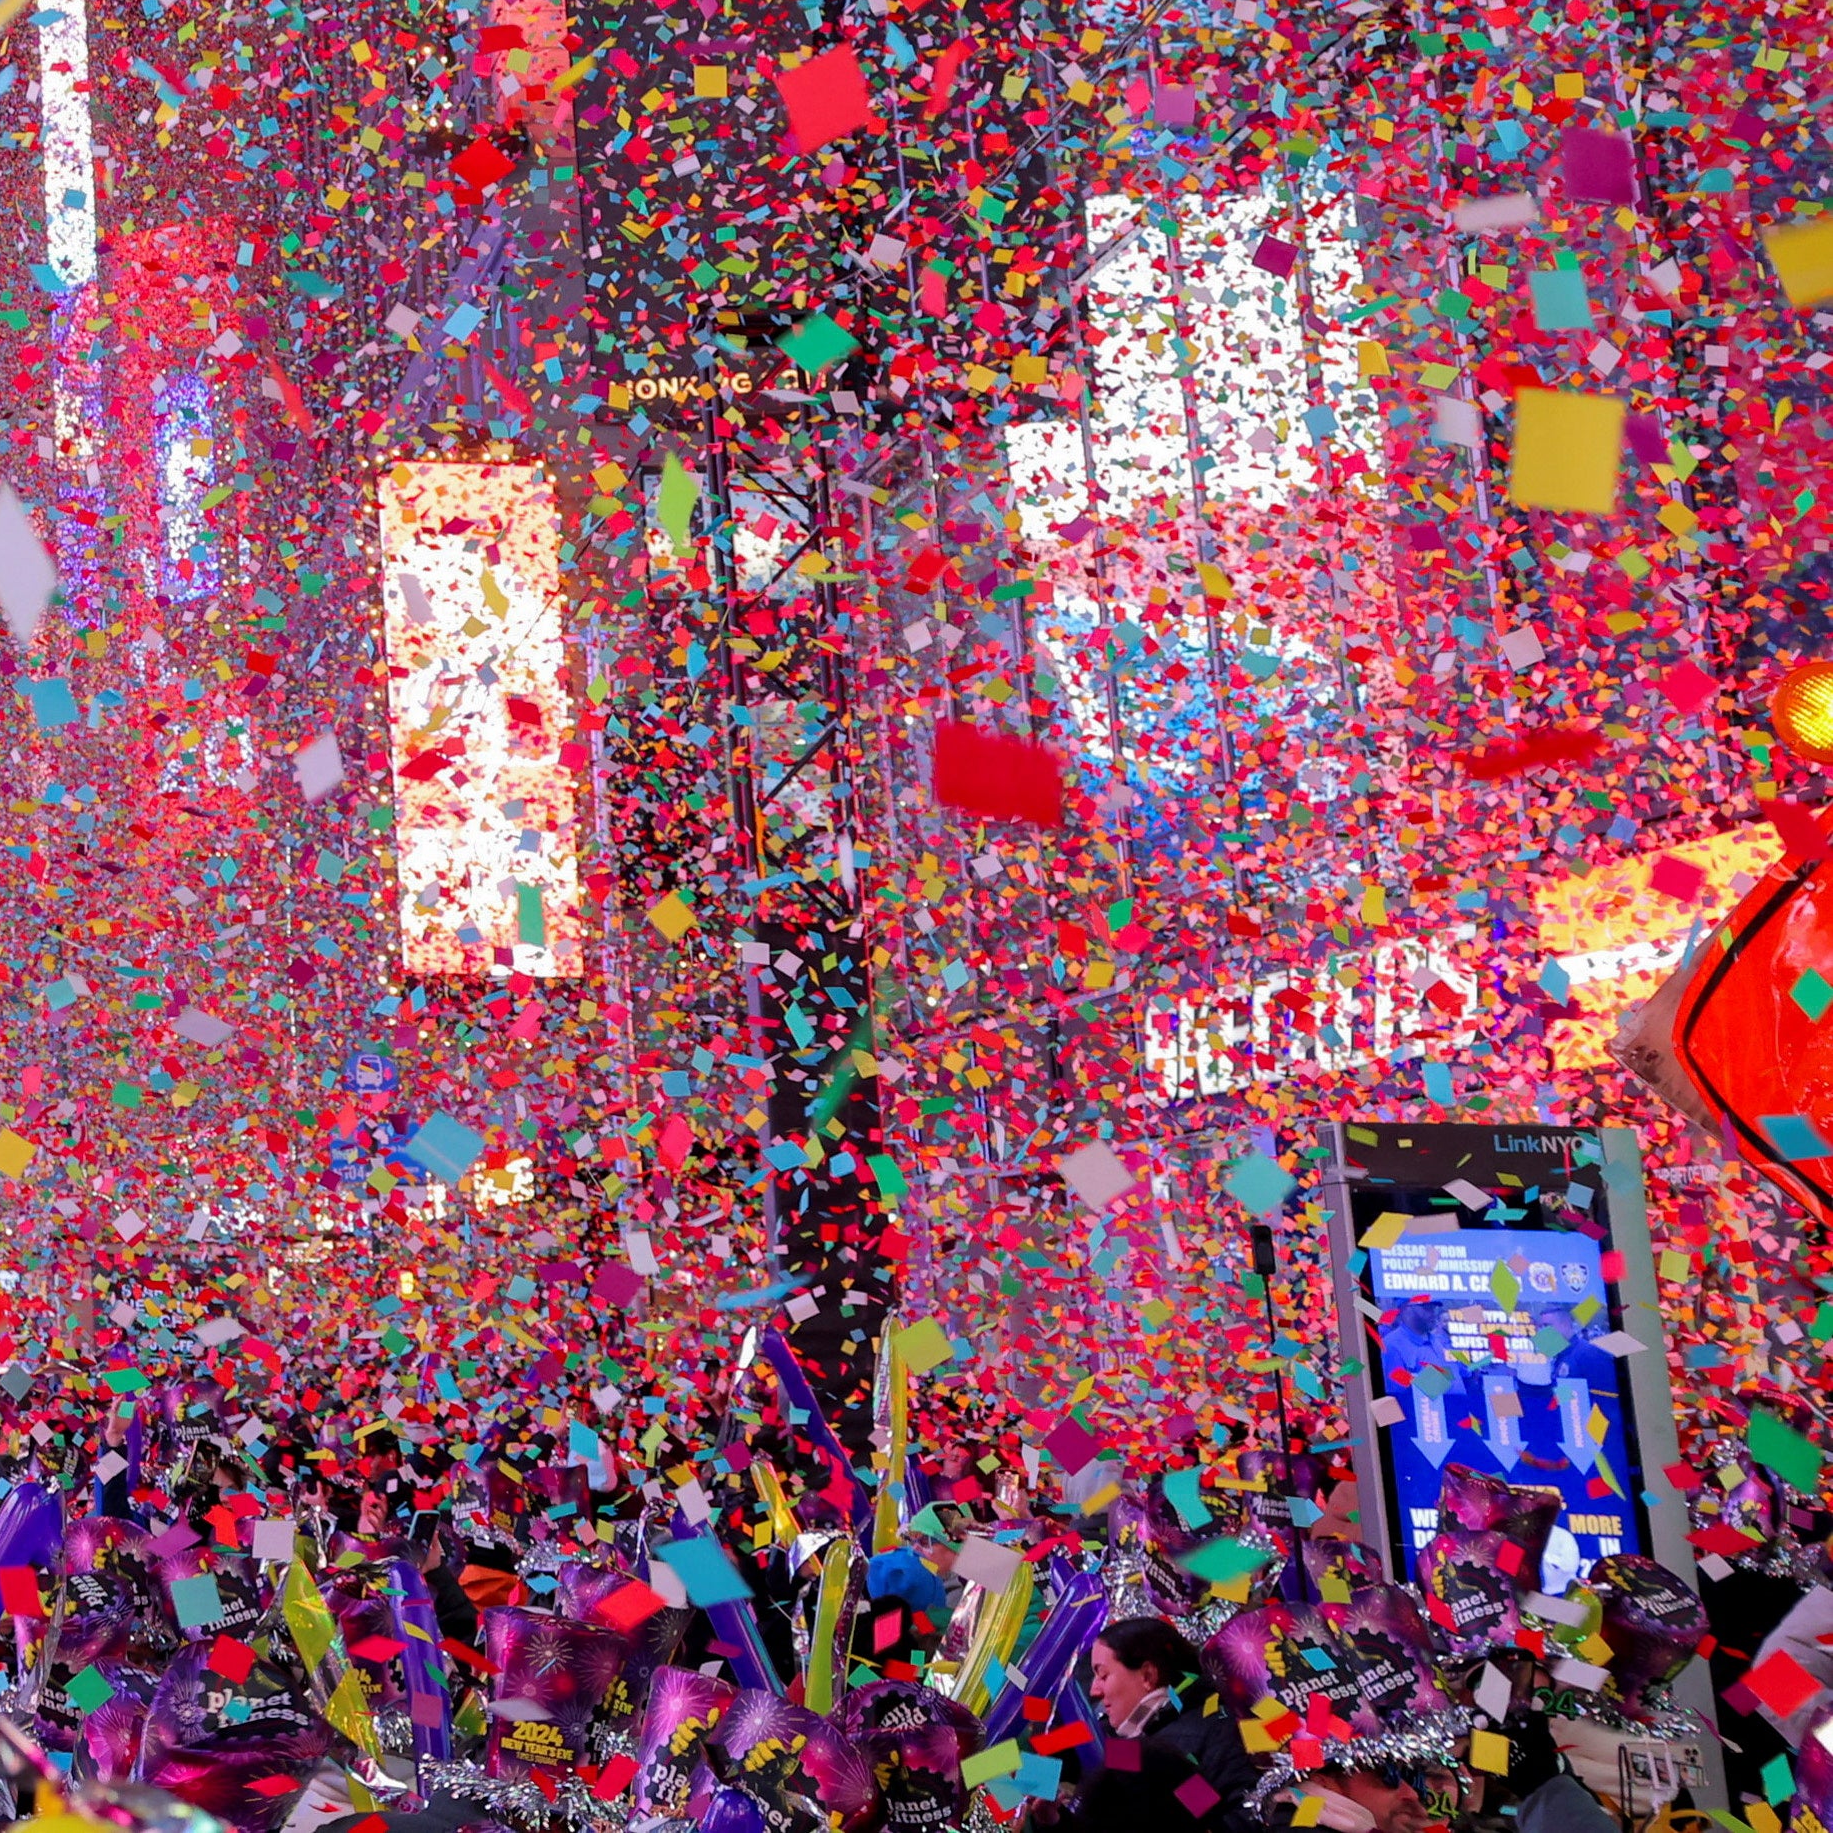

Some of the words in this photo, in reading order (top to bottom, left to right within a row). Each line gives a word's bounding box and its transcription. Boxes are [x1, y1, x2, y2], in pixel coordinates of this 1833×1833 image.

[1380, 1244, 1427, 1258] MESSAG
[1383, 1273, 1450, 1291] EDWARD
[1452, 1274, 1469, 1292] A.
[1410, 1507, 1439, 1528] WE
[1568, 1513, 1624, 1536] MORE
[1598, 1537, 1622, 1558] IN
[1447, 1590, 1489, 1614] anet
[1452, 1600, 1507, 1626] itness
[1355, 1659, 1397, 1689] anet
[1361, 1670, 1419, 1701] itness
[1279, 1670, 1337, 1704] planet
[208, 1689, 292, 1714] planet
[217, 1706, 307, 1729] fness
[513, 1721, 563, 1746] 2024
[500, 1737, 525, 1752] NEW
[523, 1740, 555, 1759] YEAR'S
[554, 1746, 575, 1760] EVE
[651, 1763, 689, 1789] pla
